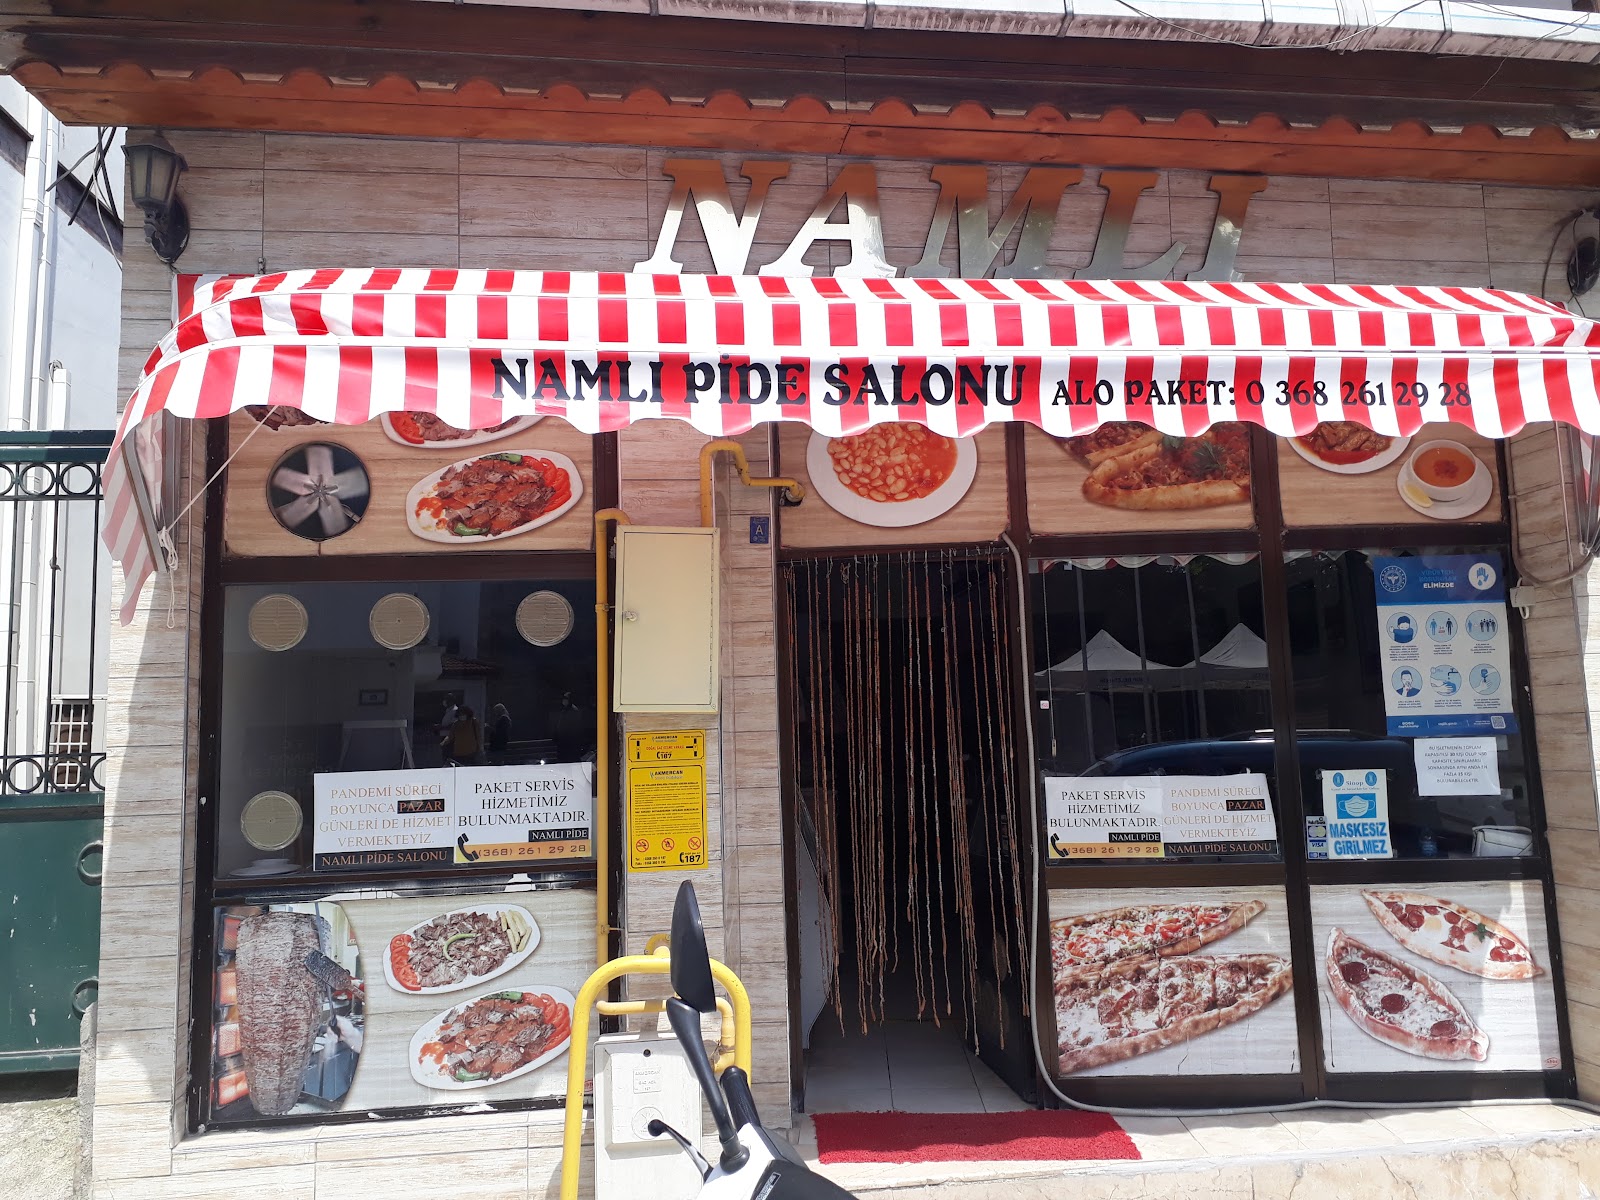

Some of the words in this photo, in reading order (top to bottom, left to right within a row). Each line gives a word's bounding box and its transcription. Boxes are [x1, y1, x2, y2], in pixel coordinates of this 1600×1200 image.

[633, 158, 1267, 282] NAMLI
[491, 357, 664, 403] NAMLI
[682, 354, 807, 405] PİDE
[823, 363, 1026, 406] SALONU
[1052, 379, 1114, 405] ALO
[1125, 379, 1235, 406] PAKET:
[1245, 380, 1265, 406] 0
[1275, 380, 1329, 407] 368
[1341, 380, 1387, 407] 261
[1395, 381, 1429, 407] 29
[1438, 382, 1472, 407] 28
[756, 524, 764, 535] A
[331, 785, 391, 798] PANDEMİ
[396, 783, 441, 796] SÜRECİ
[475, 782, 521, 793] PAKET
[526, 778, 574, 792] SERVİS
[1171, 787, 1220, 797] PANDEMİ
[1224, 786, 1262, 796] SÜRECİ
[1062, 791, 1100, 800] PAKET
[1104, 789, 1145, 800] SERVİS
[481, 793, 568, 810] HİZMETİMİZ
[1172, 802, 1225, 811] BOYUNCA
[1228, 801, 1264, 810] PAZAR
[330, 803, 395, 815] BOYUNCA
[400, 801, 442, 812] PAZAR
[1068, 803, 1140, 814] HİZMETİMİZ
[320, 818, 377, 832] GÜNLERİ
[382, 819, 398, 829] DE
[403, 816, 452, 828] HİZMET
[458, 811, 590, 827] BULUNMAKTADIR.
[1050, 818, 1161, 827] BULUNMAKTADIR.
[1164, 814, 1211, 825] GÜNLERİ
[1214, 815, 1228, 823] DE
[1232, 813, 1272, 823] HİZMET
[532, 831, 563, 840] NAMLI
[566, 829, 587, 838] PİDE
[1141, 832, 1159, 840] PİDE
[1180, 828, 1260, 838] VERMEKTEYİZ.
[337, 832, 435, 847] VERMEKTEYİZ.
[549, 846, 564, 854] 29
[1168, 845, 1202, 854] NAMLI
[1205, 843, 1227, 852] PİDE
[1230, 843, 1271, 851] SALONU
[322, 855, 362, 866] NAMLI
[367, 853, 393, 864] PİDE
[398, 851, 447, 862] SALONU
